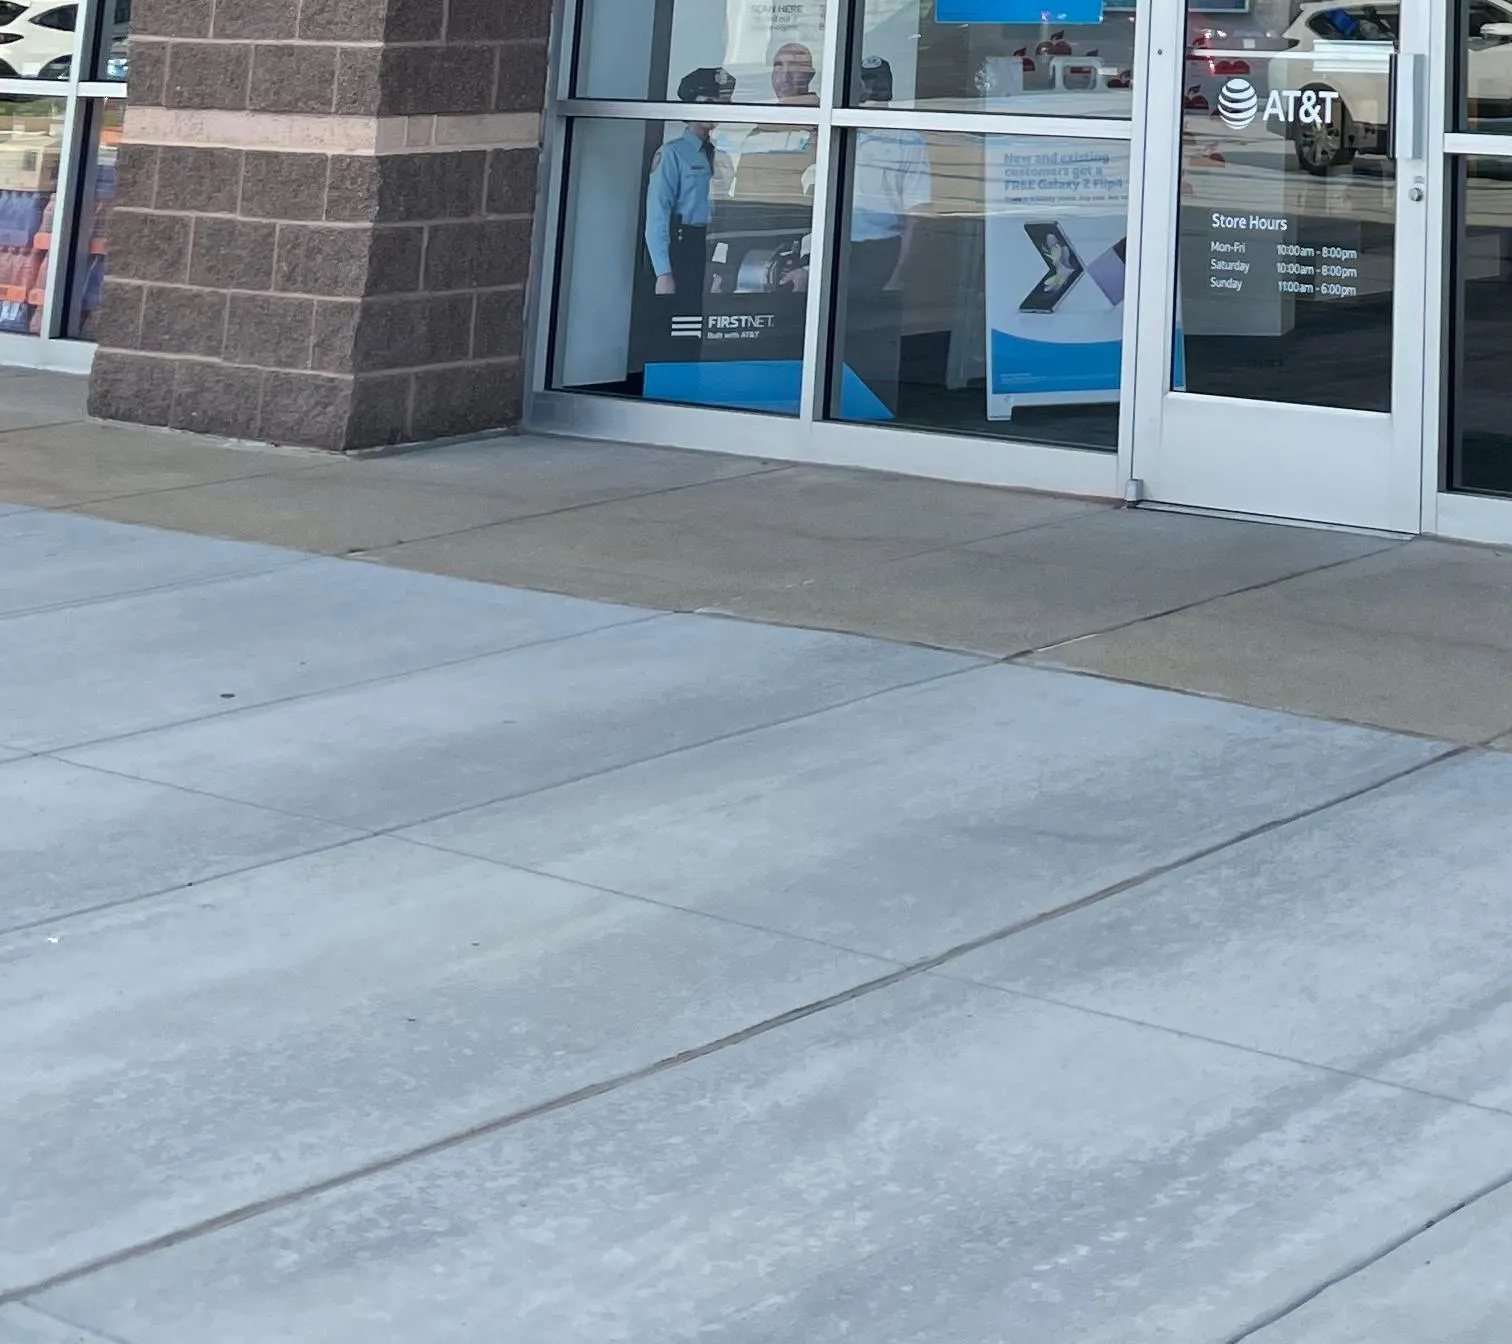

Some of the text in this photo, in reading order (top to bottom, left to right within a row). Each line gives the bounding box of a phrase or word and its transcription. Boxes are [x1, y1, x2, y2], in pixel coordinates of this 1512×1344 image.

[779, 4, 803, 14] HERE
[1263, 90, 1339, 124] AT&T
[1005, 167, 1069, 178] customers
[1005, 180, 1036, 191] FREE
[1038, 178, 1081, 192] Galaxy
[1211, 213, 1288, 231] Store Hours
[1210, 241, 1246, 254] Mon-Fri
[1276, 244, 1315, 257] 10:00am
[1322, 246, 1358, 261] 8:00pm
[1210, 259, 1251, 274] Saturday
[1210, 277, 1243, 291] Sunday
[708, 315, 775, 328] FIRSTNET
